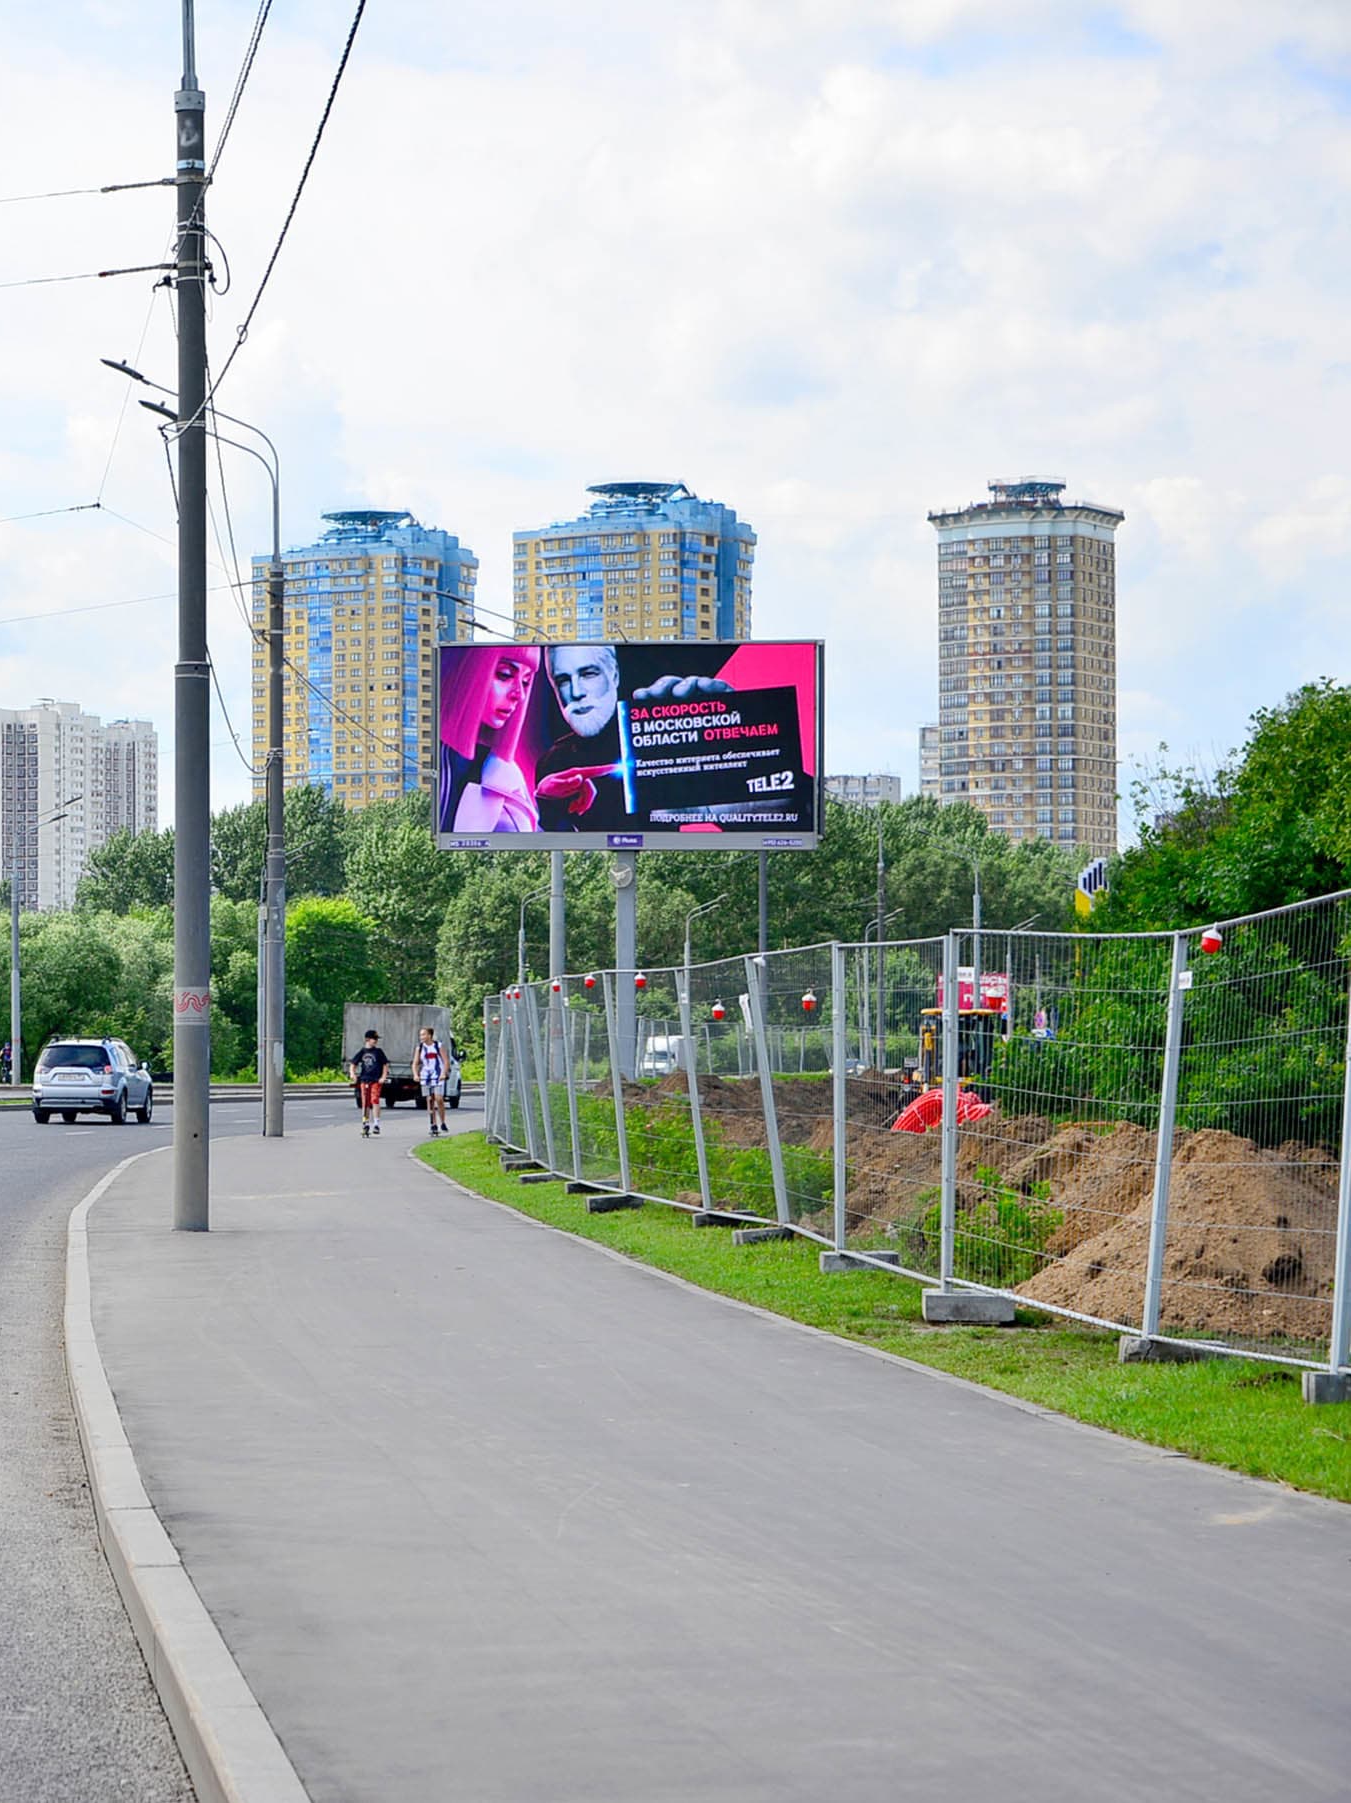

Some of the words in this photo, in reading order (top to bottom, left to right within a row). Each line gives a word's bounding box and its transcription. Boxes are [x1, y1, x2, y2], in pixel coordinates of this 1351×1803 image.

[630, 707, 650, 720] ЗА
[651, 701, 727, 718] СКОРОСТЬ
[631, 722, 642, 734] В
[644, 711, 741, 733] МОСКОВСКОЙ
[632, 731, 699, 747] ОБЛАСТИ
[703, 723, 779, 741] ОТВЕЧАЕМ
[636, 759, 674, 768] Качество
[676, 754, 720, 767] интернета
[722, 749, 780, 760] обеспечивает
[636, 763, 701, 778] искусственный
[702, 760, 748, 771] интеллект
[745, 770, 795, 793] TELE2
[705, 813, 718, 823] НА
